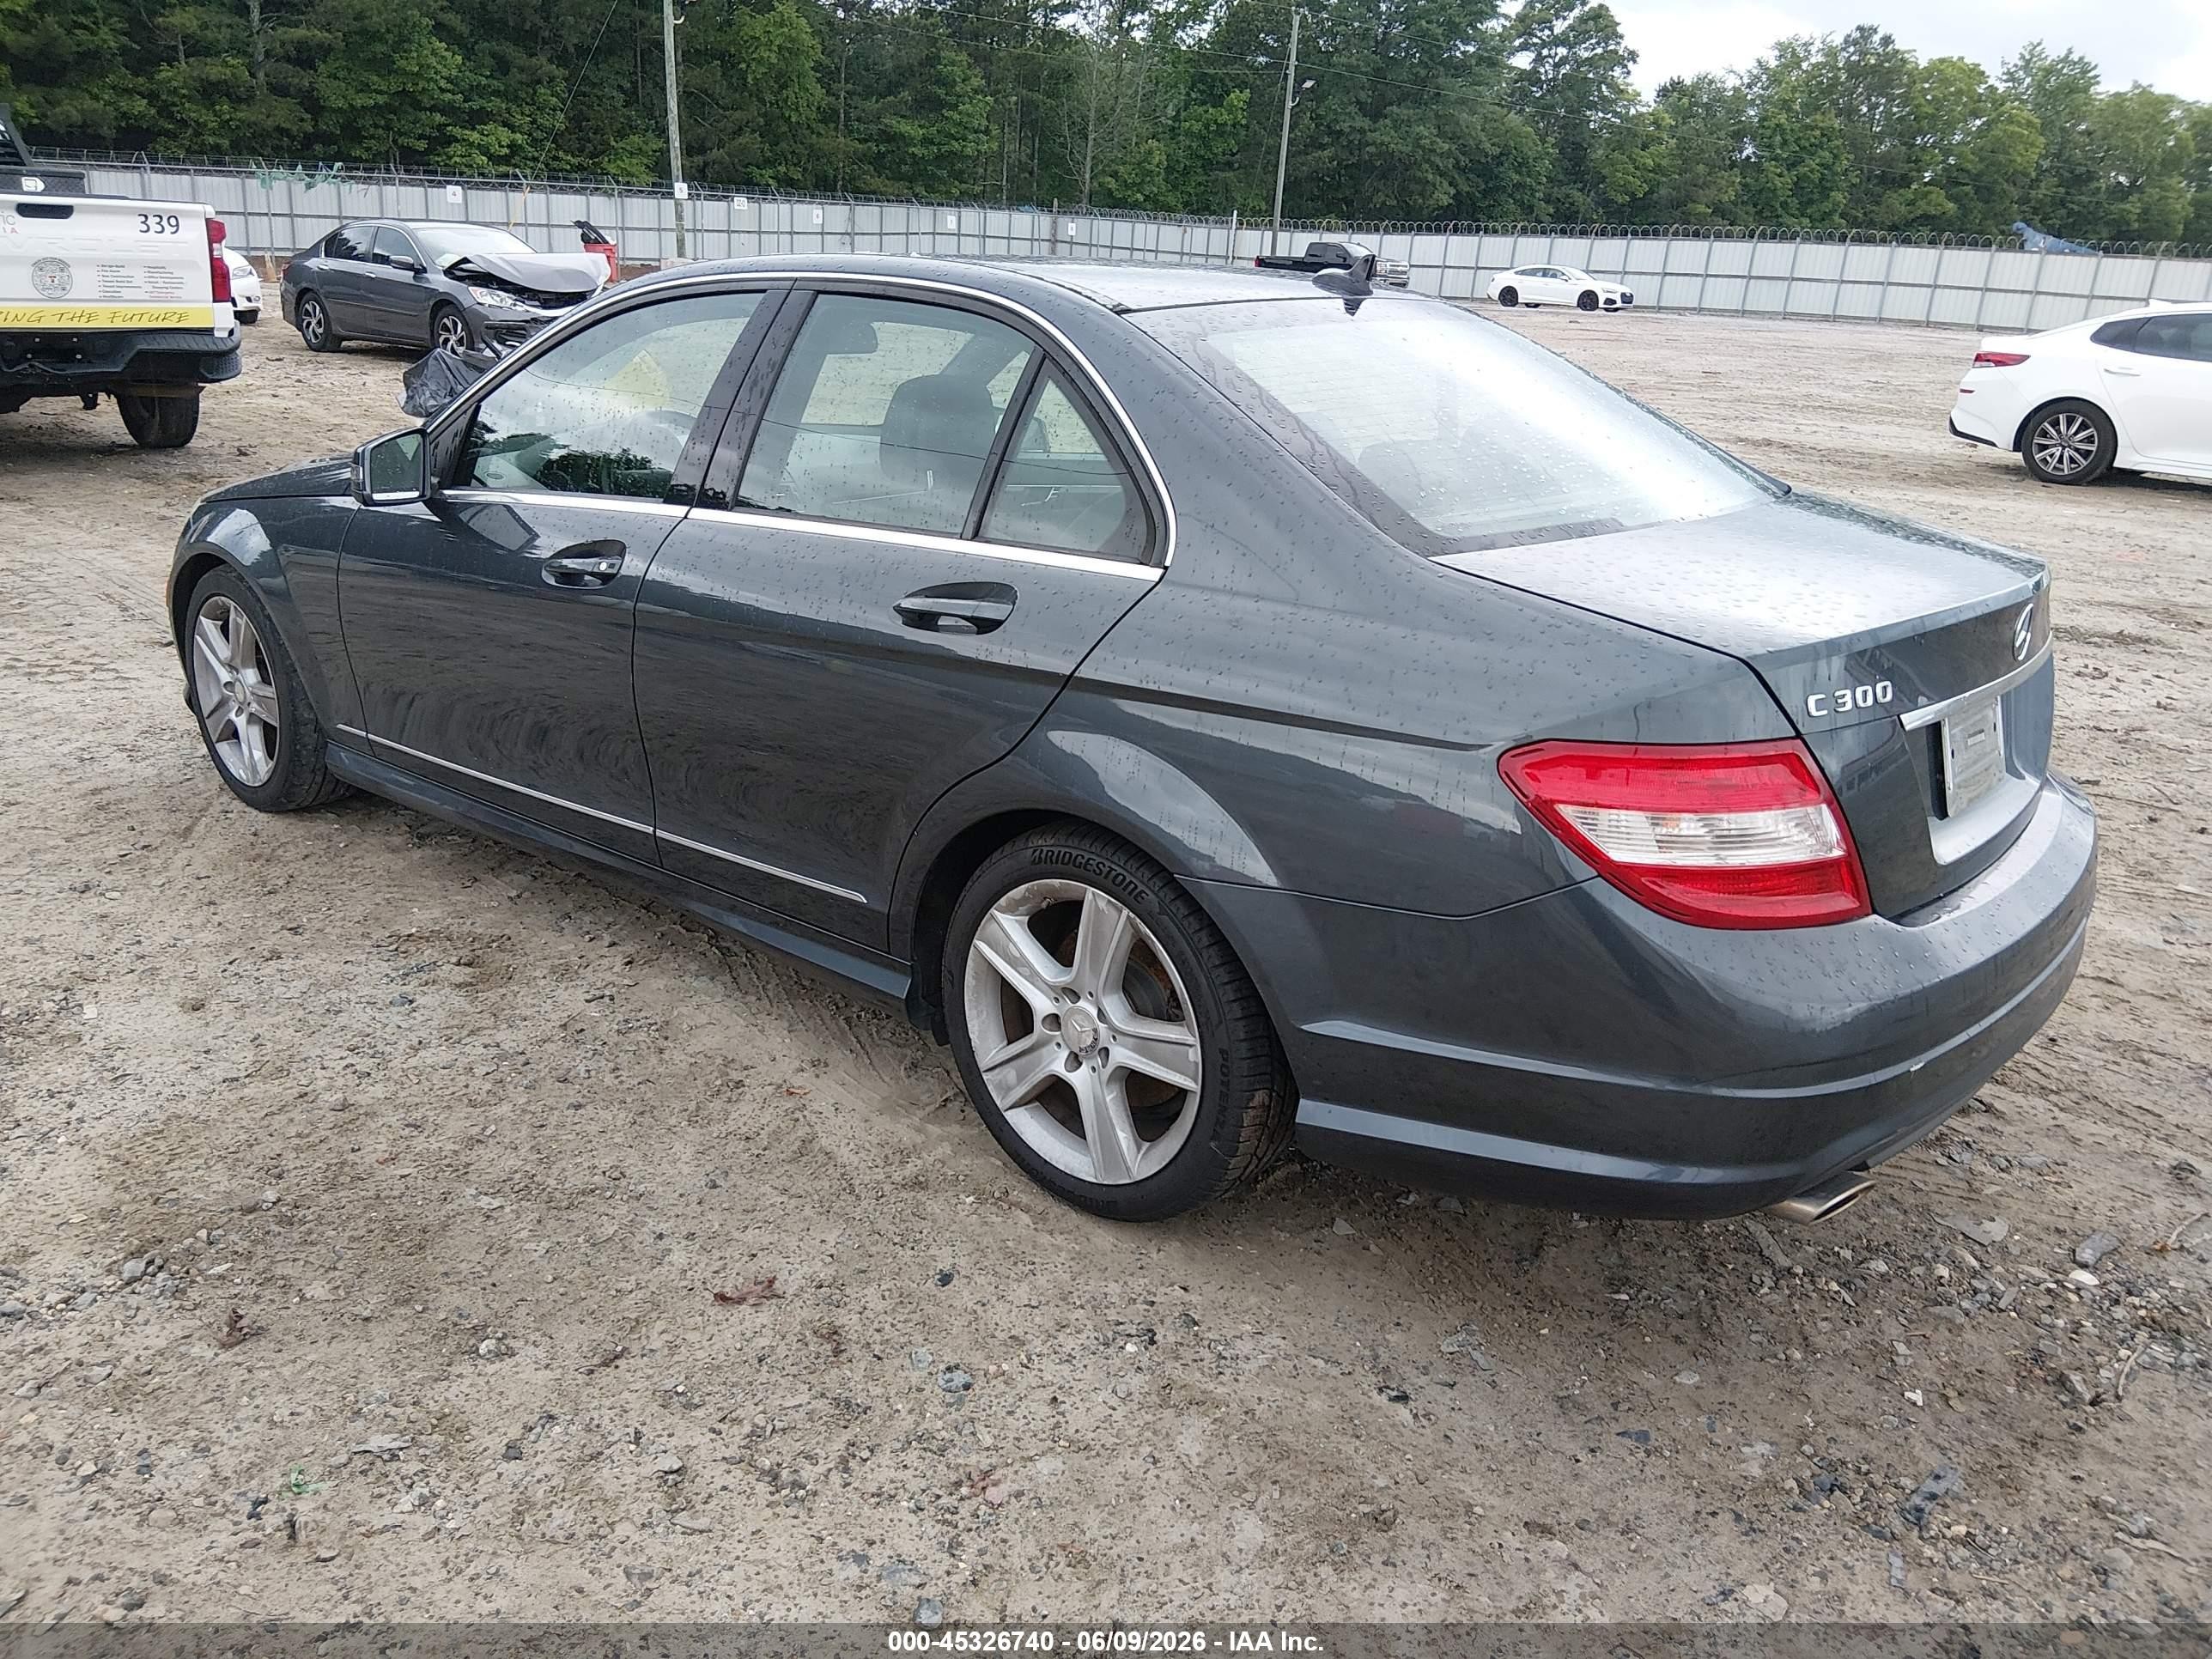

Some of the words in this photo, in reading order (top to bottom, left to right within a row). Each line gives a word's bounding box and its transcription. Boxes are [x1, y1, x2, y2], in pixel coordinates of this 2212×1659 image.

[137, 214, 179, 234] 339
[51, 309, 99, 323] THE
[107, 311, 189, 323] FUTURE
[1807, 694, 1828, 717] C
[1833, 681, 1893, 713] 300
[1030, 848, 1149, 904] BRIDGESTONE
